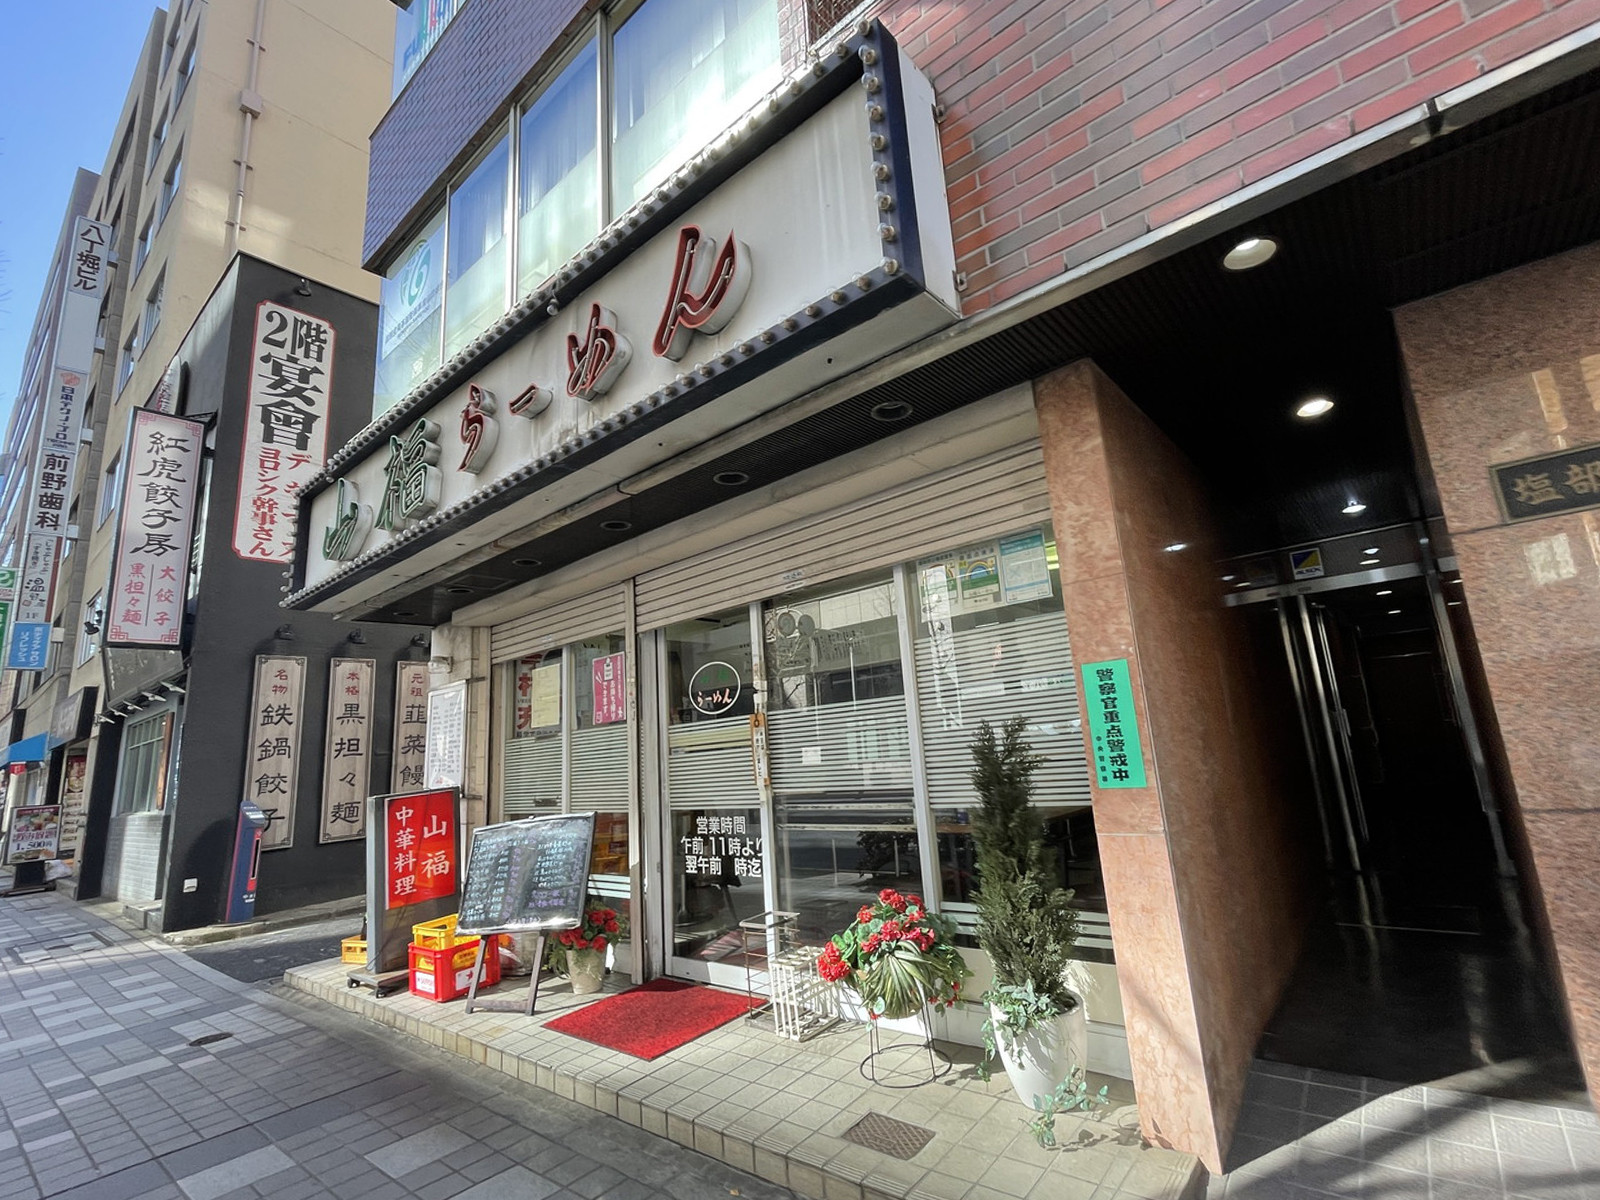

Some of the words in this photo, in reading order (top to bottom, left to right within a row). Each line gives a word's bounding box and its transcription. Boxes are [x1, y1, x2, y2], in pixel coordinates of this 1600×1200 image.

[74, 225, 104, 291] 八丁堀ビル
[34, 453, 71, 531] 前野歯科
[130, 430, 192, 557] 紅虎餃子房
[248, 446, 282, 557] ヨロシク幹事さん
[121, 563, 146, 626] 黒担々麺
[153, 565, 177, 626] 大餃子
[272, 669, 289, 695] 名物
[345, 672, 360, 696] 本格
[410, 673, 425, 697] 元祖
[697, 687, 733, 708] らーめん
[1096, 668, 1130, 781] 警察官重点警戒中
[255, 703, 294, 832] 鉄鍋餃子
[330, 703, 365, 824] 黒担々麺
[393, 805, 417, 896] 中華料理
[421, 814, 451, 879] 山福
[696, 815, 746, 835] 営業時間
